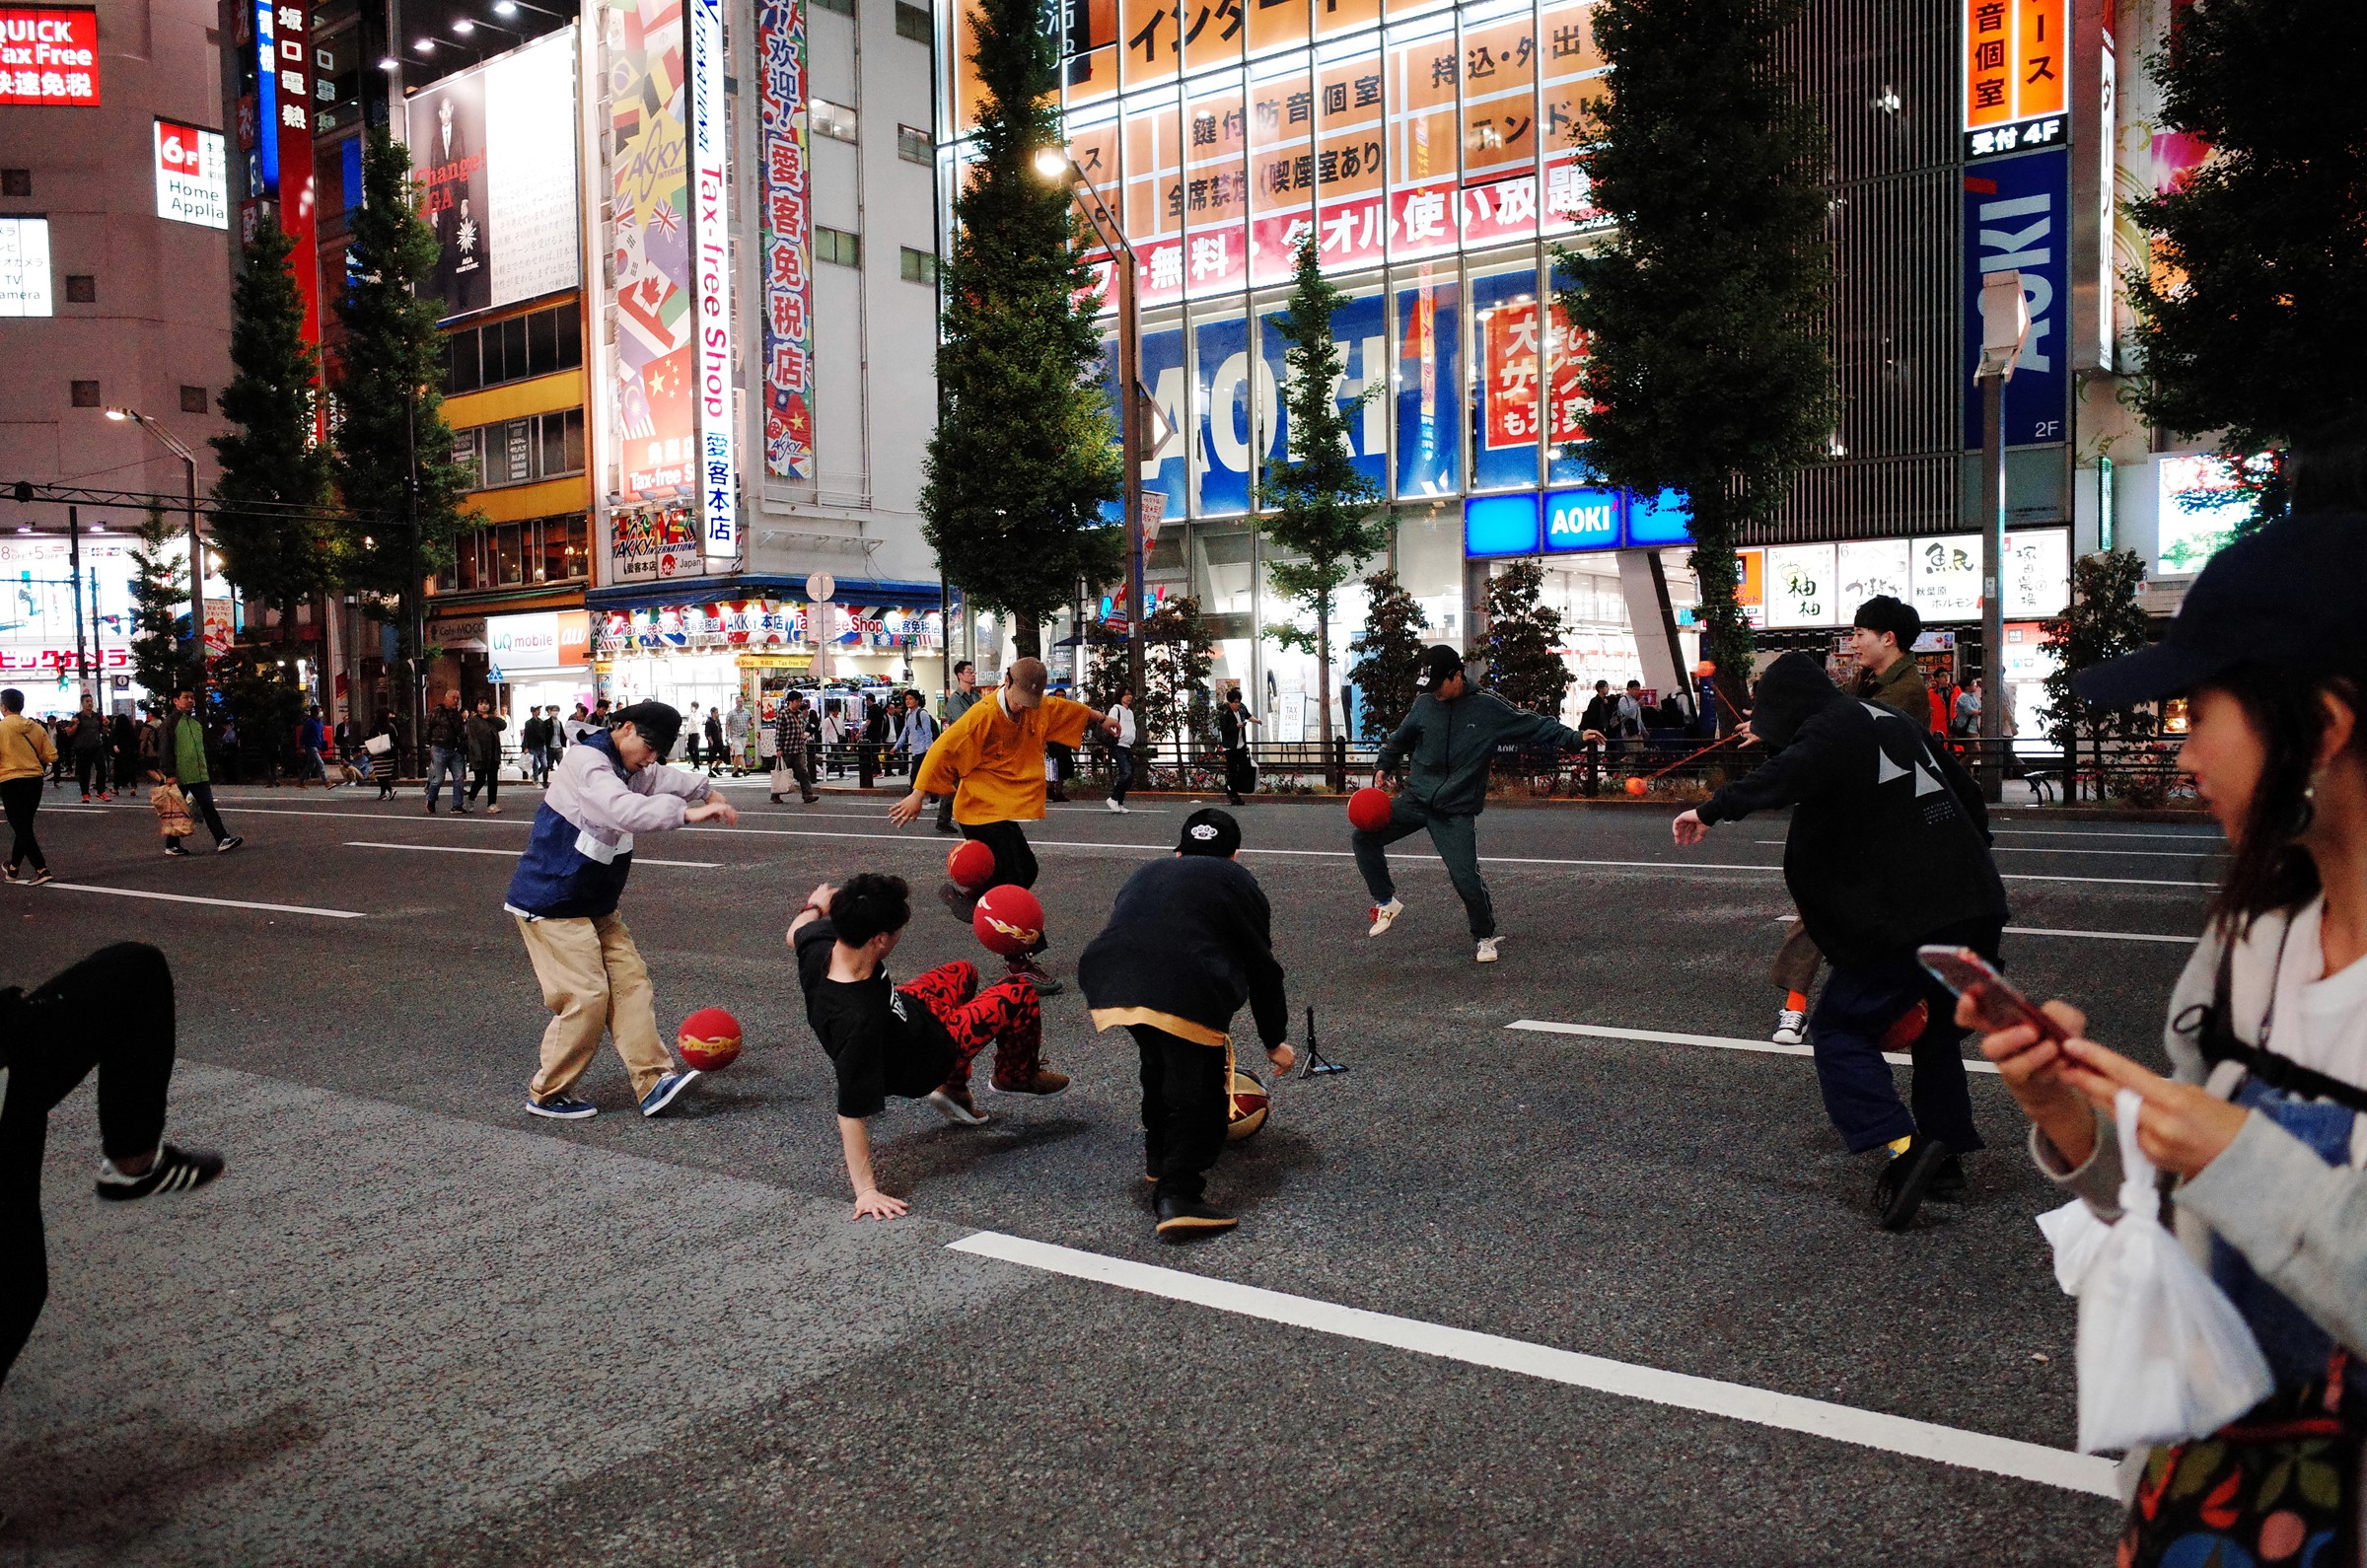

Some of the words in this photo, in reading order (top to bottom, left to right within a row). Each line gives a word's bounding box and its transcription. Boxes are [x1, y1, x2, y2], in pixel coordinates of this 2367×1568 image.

[0, 43, 34, 65] ax
[36, 43, 93, 66] Free
[278, 6, 307, 130] 坂口電熱
[1192, 75, 1381, 147] 鍵付防音個室
[1972, 126, 2018, 155] 受付
[2023, 119, 2060, 144] 4F
[413, 146, 486, 191] Change!
[169, 178, 219, 201] Home
[171, 197, 225, 219] Applia
[701, 164, 725, 317] Tax-free
[772, 143, 803, 390] 愛客免税店
[4, 275, 23, 285] TV
[704, 326, 728, 418] Shop
[2035, 421, 2059, 438] 2F
[630, 467, 682, 491] Tax-free
[706, 431, 730, 541] 愛客本店
[1550, 505, 1610, 535] AOKI
[1925, 541, 1974, 574] 魚民
[1932, 597, 1975, 609] ホルモン
[658, 620, 681, 634] Shop
[760, 614, 784, 630] 本店
[851, 615, 884, 633] Shop
[493, 633, 513, 651] UQ
[514, 633, 553, 648] mobile
[561, 626, 587, 646] au
